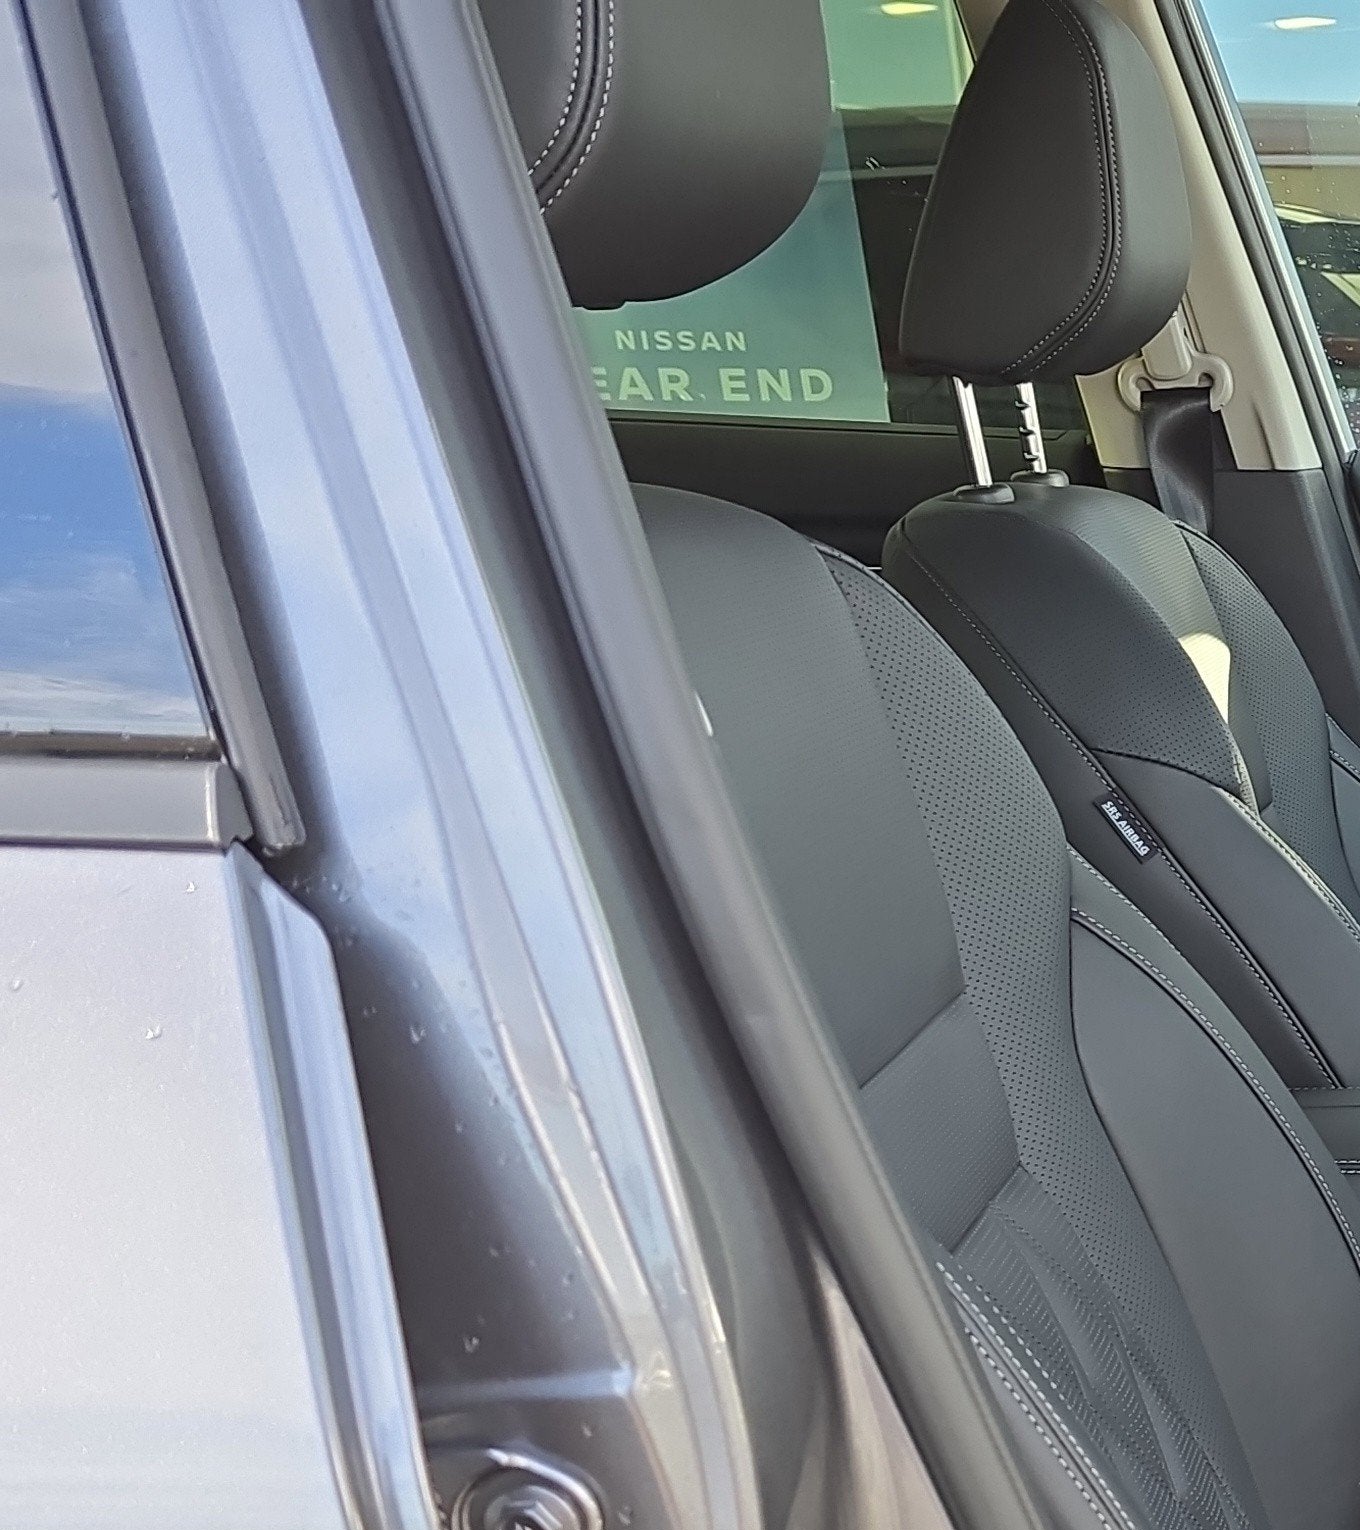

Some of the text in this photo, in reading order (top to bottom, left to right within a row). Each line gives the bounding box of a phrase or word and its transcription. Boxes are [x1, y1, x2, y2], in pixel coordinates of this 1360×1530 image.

[614, 329, 747, 351] NISSAN
[718, 367, 833, 402] END
[1101, 801, 1151, 856] SRS AIRBAG
